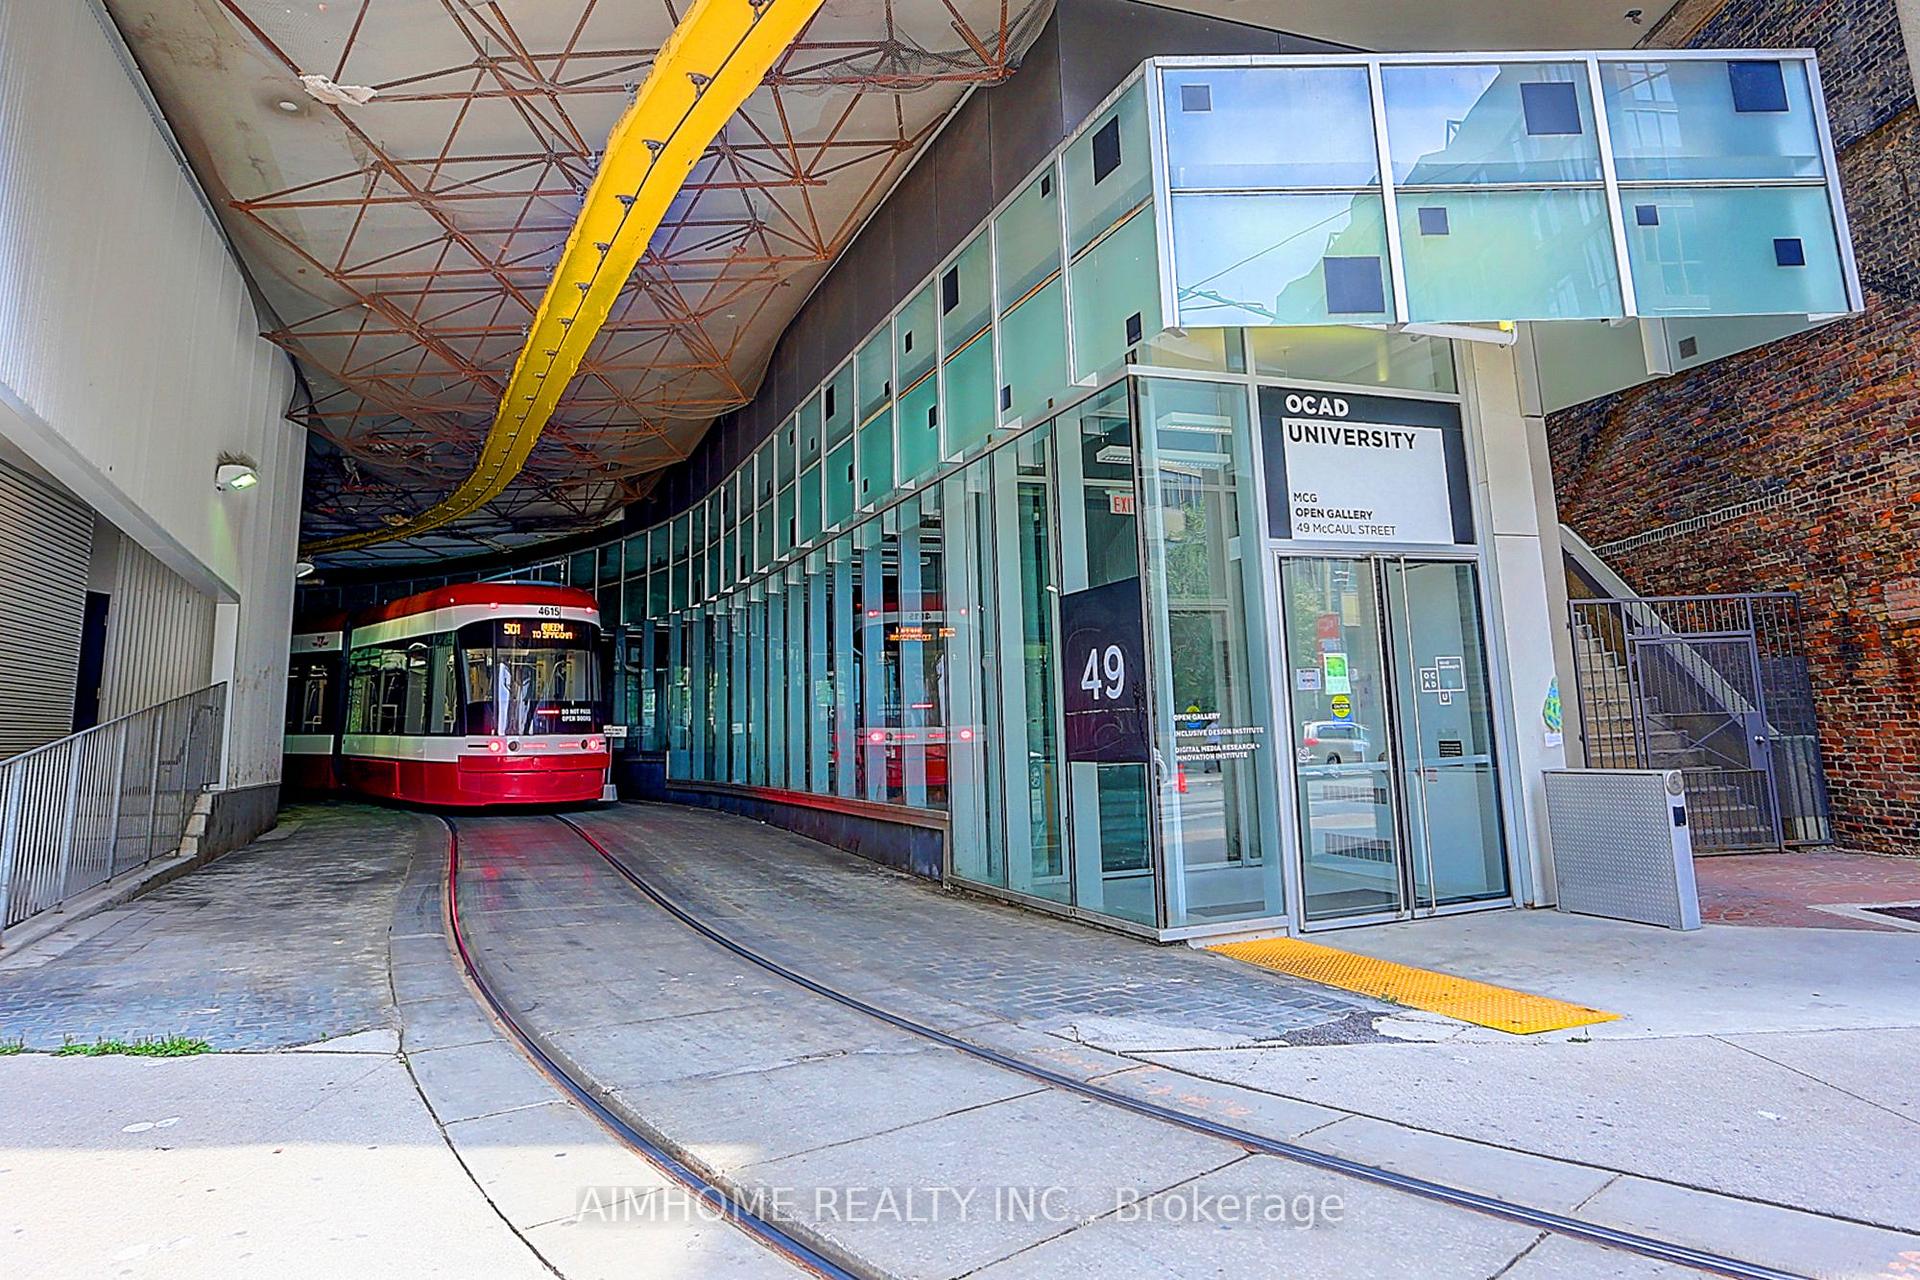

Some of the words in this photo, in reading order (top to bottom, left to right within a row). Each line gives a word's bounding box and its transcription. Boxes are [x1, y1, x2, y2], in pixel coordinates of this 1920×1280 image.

[1285, 394, 1349, 417] OCAD
[1288, 424, 1416, 450] UNIVERSITY
[1293, 492, 1318, 503] MCG
[1295, 507, 1325, 519] OPEN
[1326, 508, 1373, 520] GALLERY
[1296, 523, 1310, 533] 49
[1313, 523, 1356, 535] McCAUL
[1358, 525, 1397, 536] STREET
[538, 606, 560, 617] 4615
[503, 623, 521, 635] 501
[1081, 645, 1125, 700] 49
[1173, 714, 1191, 722] OPEN
[1192, 713, 1221, 721] GALLERY
[1174, 729, 1208, 738] INCLUSIVE
[1208, 728, 1232, 737] DESIGN
[1232, 726, 1264, 735] INSTITUTE
[1174, 745, 1201, 754] DIGITAL
[1200, 743, 1222, 752] MEDIA
[1222, 742, 1256, 751] RESEARCH
[1215, 751, 1248, 760] INSTITUTE
